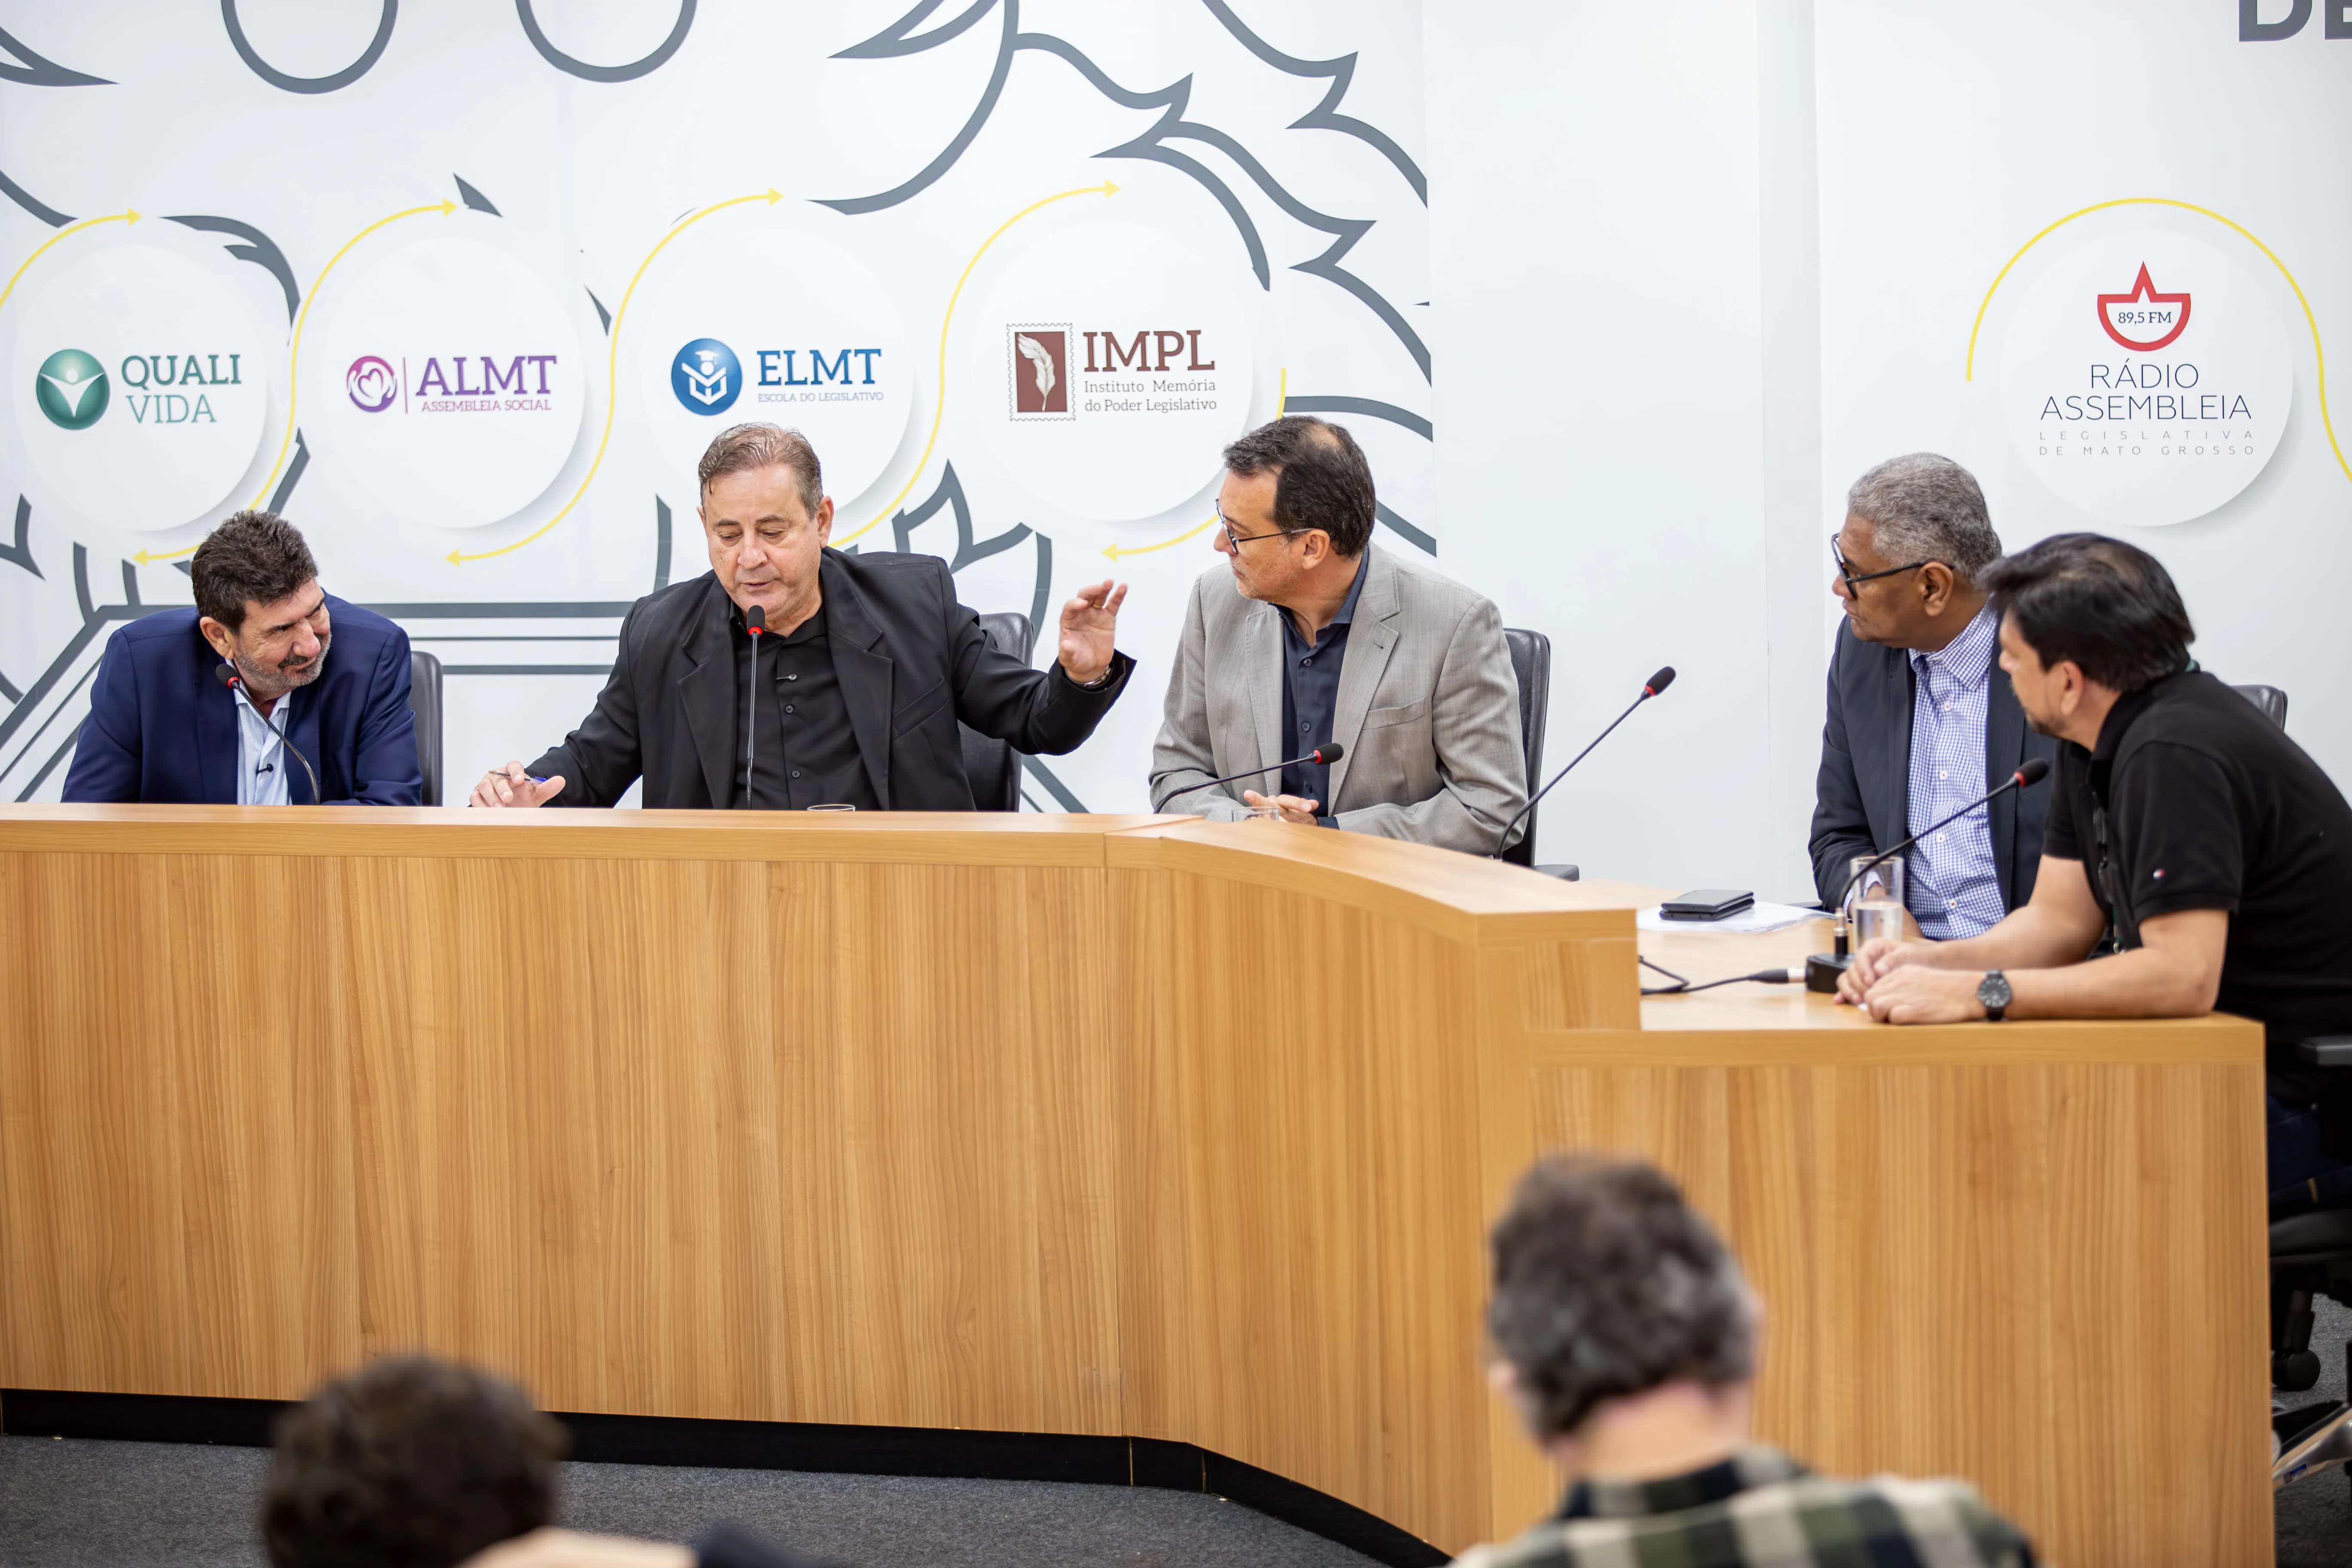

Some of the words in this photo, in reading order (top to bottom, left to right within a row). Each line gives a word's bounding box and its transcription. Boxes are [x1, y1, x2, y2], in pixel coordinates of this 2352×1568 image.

[2118, 312, 2145, 325] 89,5
[2148, 312, 2172, 323] FM
[1083, 330, 1215, 372] IMPL
[121, 354, 242, 391] QUALI
[416, 355, 557, 396] ALMT
[756, 349, 882, 386] ELMT
[2091, 358, 2199, 389] RÁDIO
[1084, 380, 1144, 393] Instituto
[1153, 379, 1216, 392] Memória
[422, 400, 501, 412] ASSEMBLEIA
[505, 399, 551, 411] SOCIAL
[758, 393, 796, 403] ESCOLA
[800, 392, 816, 402] DO
[818, 392, 884, 402] LEGISLATIVO
[1085, 399, 1101, 412] do
[1104, 399, 1142, 411] Poder
[1146, 398, 1217, 413] Legislativo
[2040, 395, 2251, 420] ASSEMBLEIA
[125, 394, 217, 424] VIDA
[2040, 430, 2252, 440] LEGISLATIVA
[2040, 446, 2062, 456] DE
[2083, 446, 2141, 455] MATO
[2161, 445, 2254, 455] GROSSO
